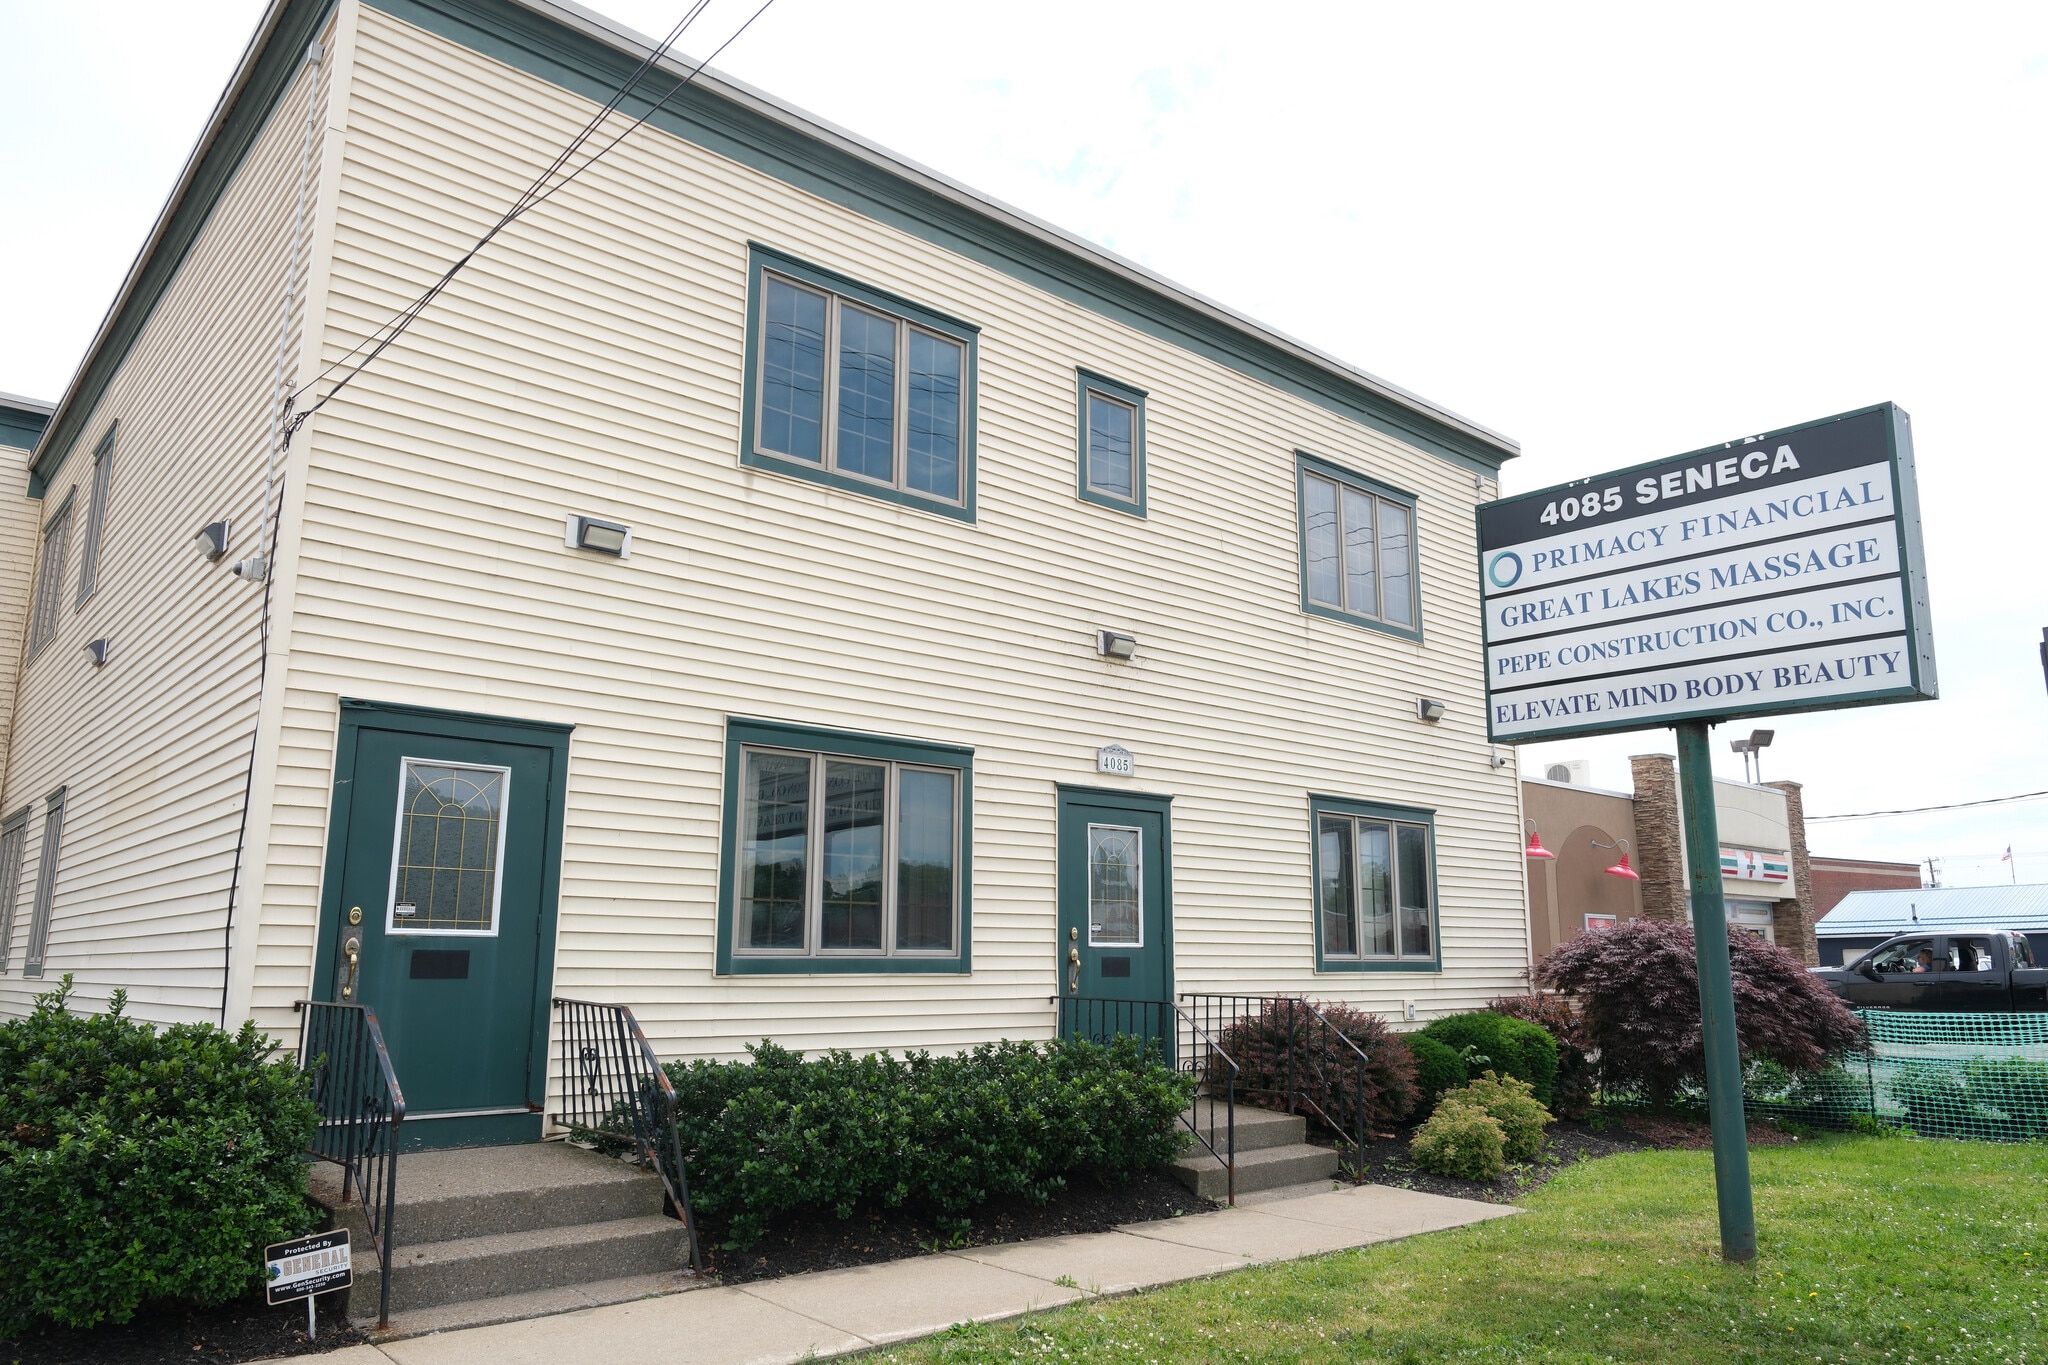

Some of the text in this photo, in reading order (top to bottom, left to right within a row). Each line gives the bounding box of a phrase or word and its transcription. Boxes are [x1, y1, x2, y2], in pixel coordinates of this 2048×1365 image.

[1540, 444, 1801, 526] 4085 SENECA
[1532, 480, 1884, 573] PRIMACY FINANCIAL
[1500, 537, 1881, 628] GREAT LAKES MASSAGE
[1497, 596, 1895, 676] PEPE CONSTRUCTION CO., INC.
[1496, 650, 1901, 724] ELEVATE MIND BODY BEAUTY
[1103, 756, 1129, 772] 4085
[283, 1248, 348, 1277] GENERAL
[285, 1240, 332, 1255] Protected By
[316, 1263, 348, 1274] SECURITY
[274, 1271, 346, 1293] www.GenSecurity.com
